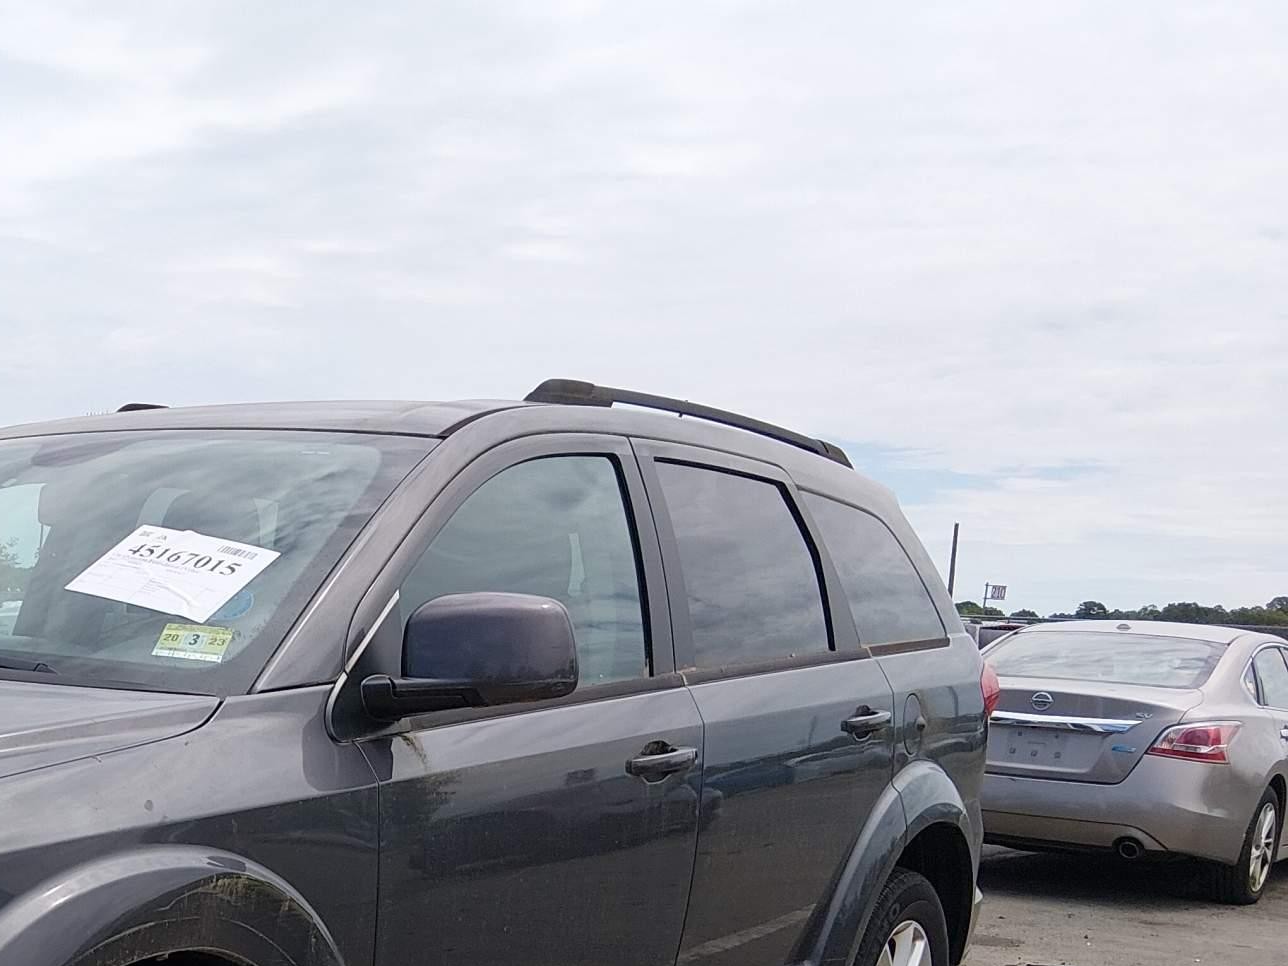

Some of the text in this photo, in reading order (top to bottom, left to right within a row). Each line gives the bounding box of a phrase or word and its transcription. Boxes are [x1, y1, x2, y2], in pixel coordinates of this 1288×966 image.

[128, 544, 242, 576] 45167015
[163, 633, 226, 647] 20 3 23
